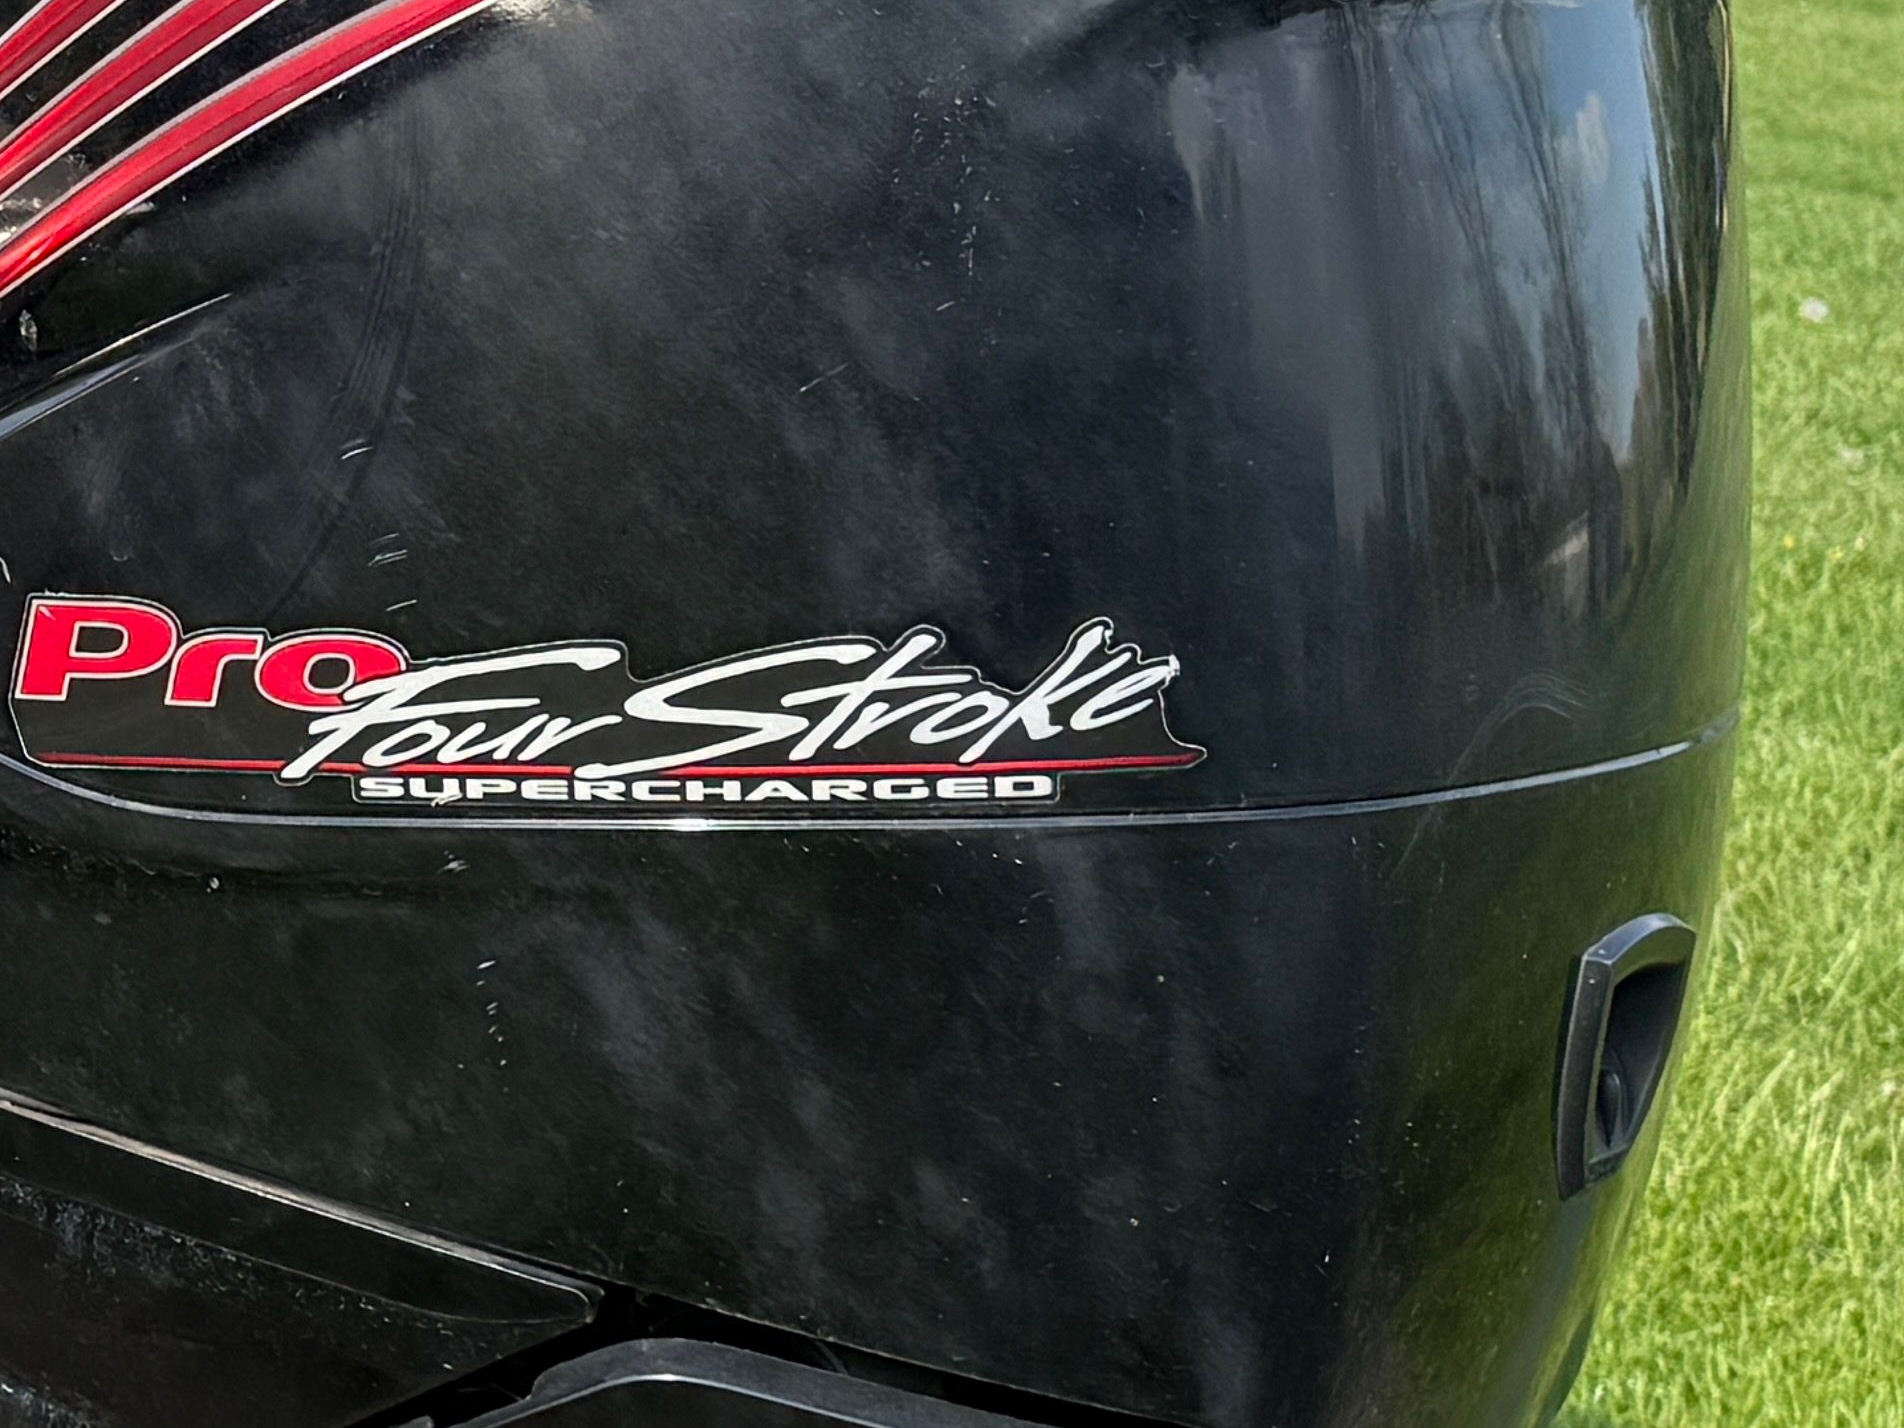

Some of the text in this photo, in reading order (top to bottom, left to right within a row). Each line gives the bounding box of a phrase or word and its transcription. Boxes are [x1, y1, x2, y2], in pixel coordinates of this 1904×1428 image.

[17, 597, 1178, 779] Pro Four Stroke
[358, 772, 1054, 804] SUPERCHARGED
